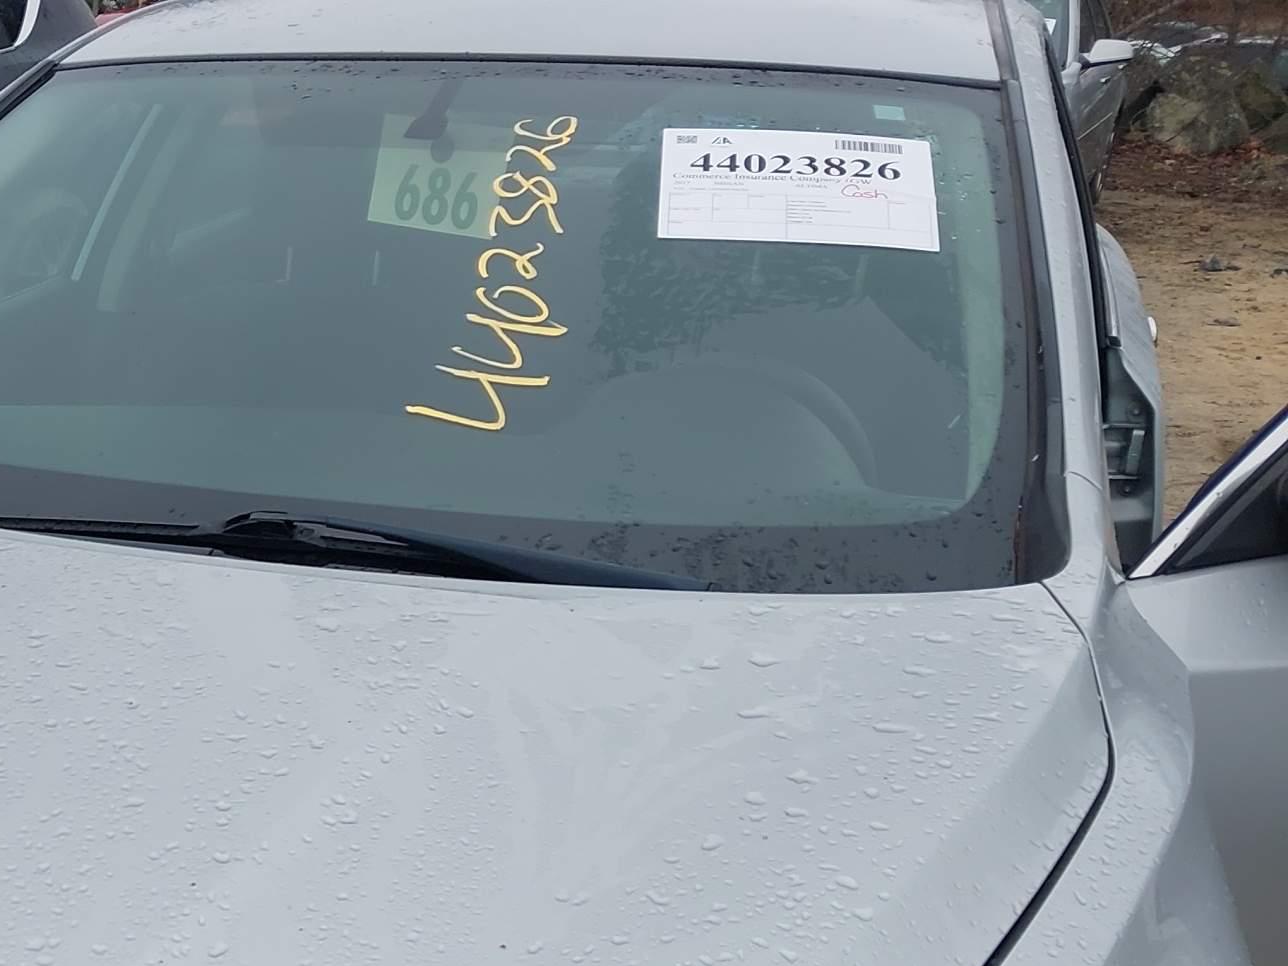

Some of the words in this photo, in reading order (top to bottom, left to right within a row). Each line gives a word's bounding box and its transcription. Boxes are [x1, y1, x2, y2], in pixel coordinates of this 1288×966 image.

[690, 152, 902, 180] 44023826
[735, 173, 787, 181] Insurance
[789, 175, 841, 184] Company
[394, 164, 478, 230] 686
[841, 184, 889, 200] Cash
[405, 115, 579, 431] 44023826
